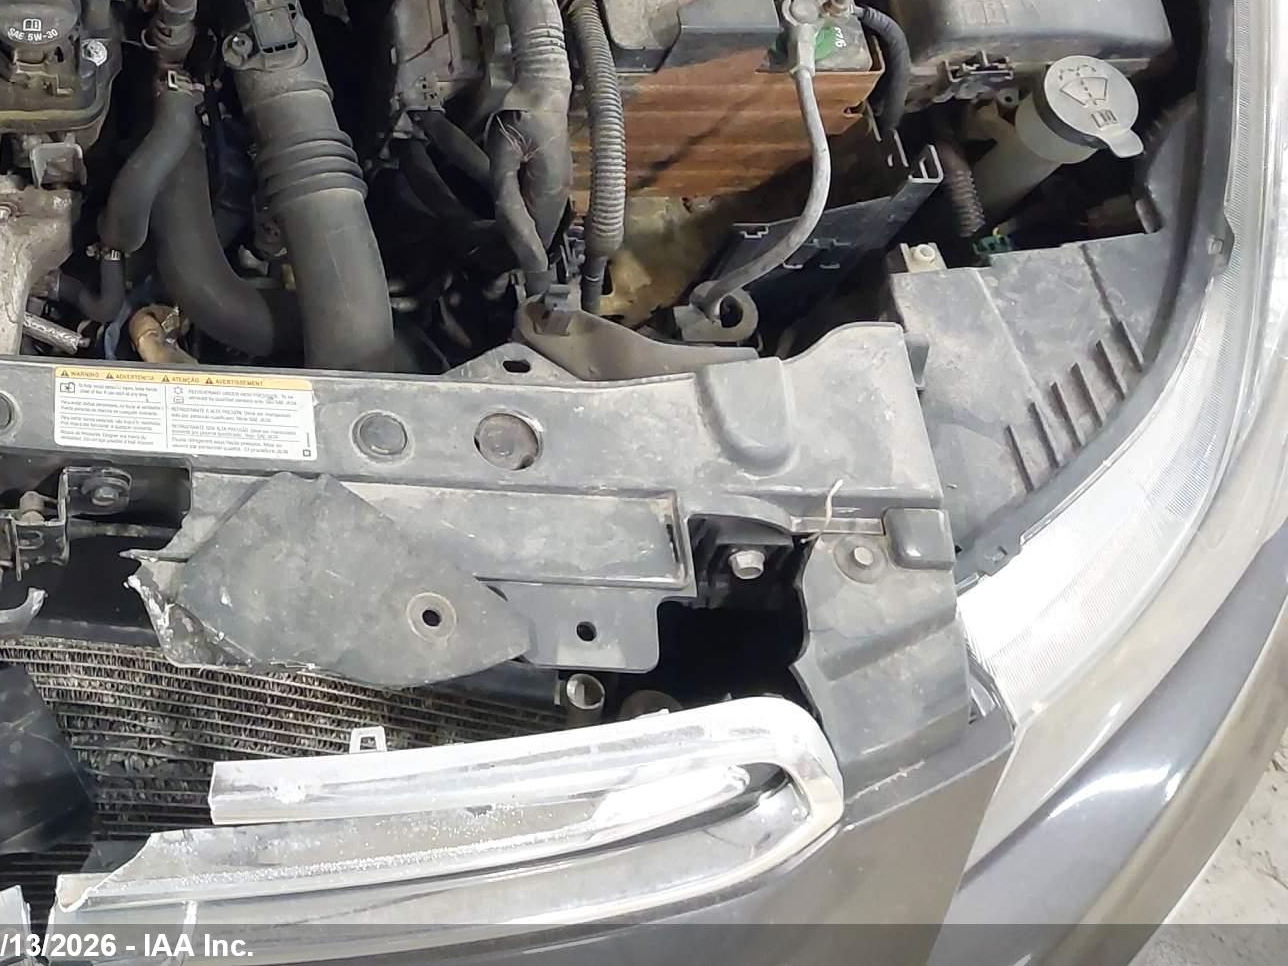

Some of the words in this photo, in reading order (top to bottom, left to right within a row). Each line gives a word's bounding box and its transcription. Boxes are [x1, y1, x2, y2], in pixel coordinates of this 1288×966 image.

[7, 27, 25, 40] SAE
[27, 28, 58, 42] 5W-30
[70, 370, 99, 379] WARNING
